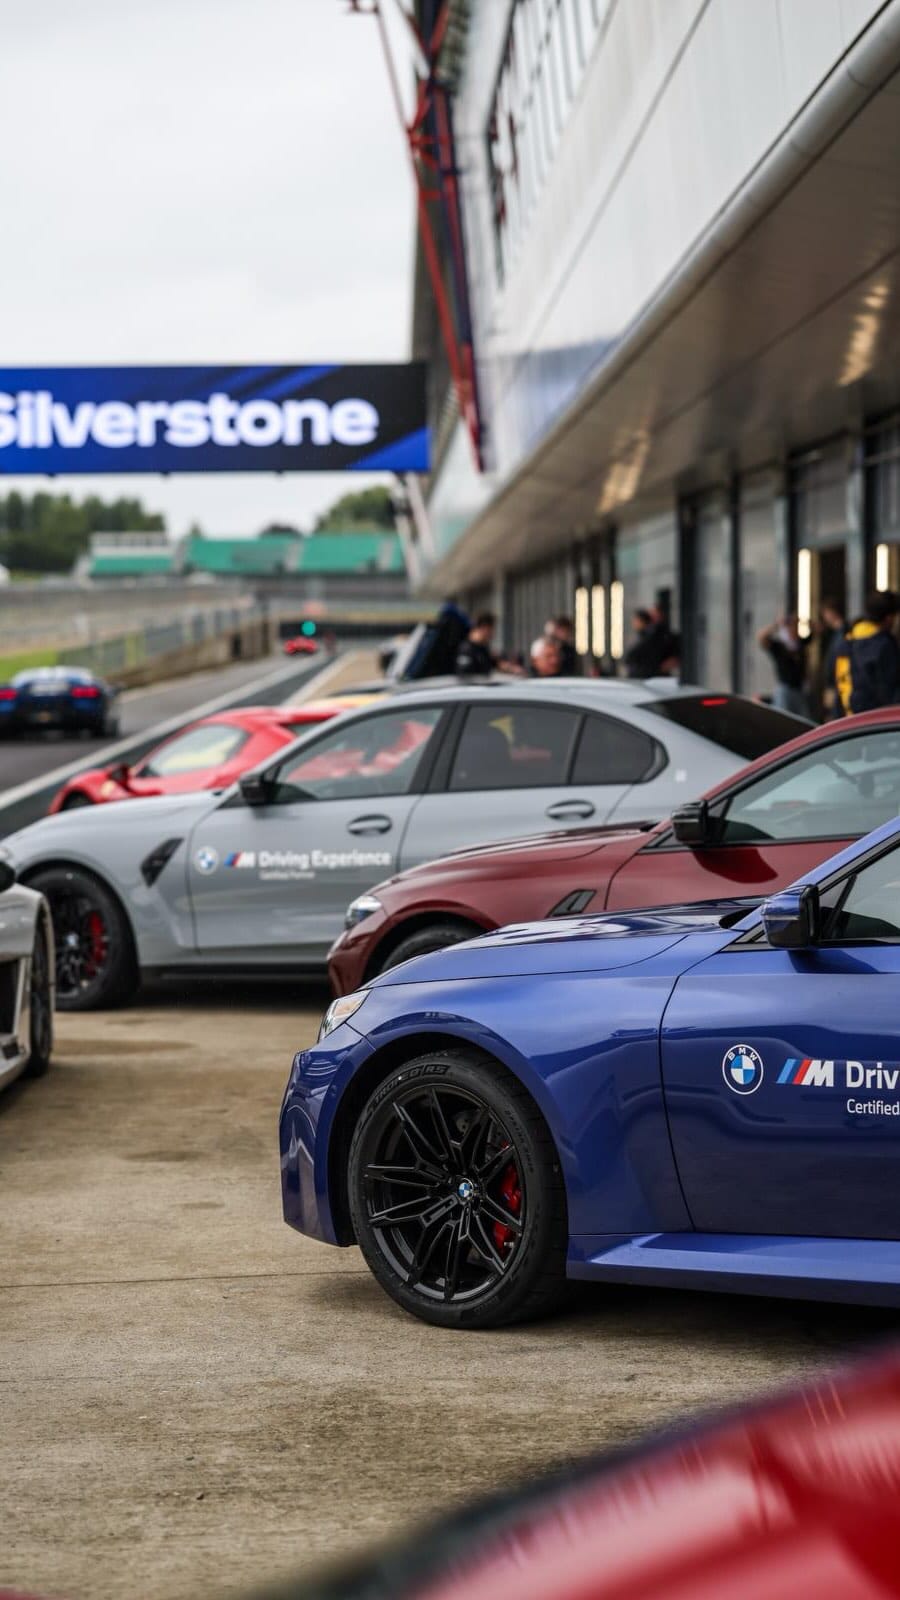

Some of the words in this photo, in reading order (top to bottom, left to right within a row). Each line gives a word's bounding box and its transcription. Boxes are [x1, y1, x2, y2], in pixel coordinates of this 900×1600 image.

[258, 851, 310, 869] Driving
[311, 850, 392, 869] Experience
[800, 1060, 834, 1087] M
[846, 1061, 900, 1089] Driv
[847, 1099, 900, 1115] Certified
